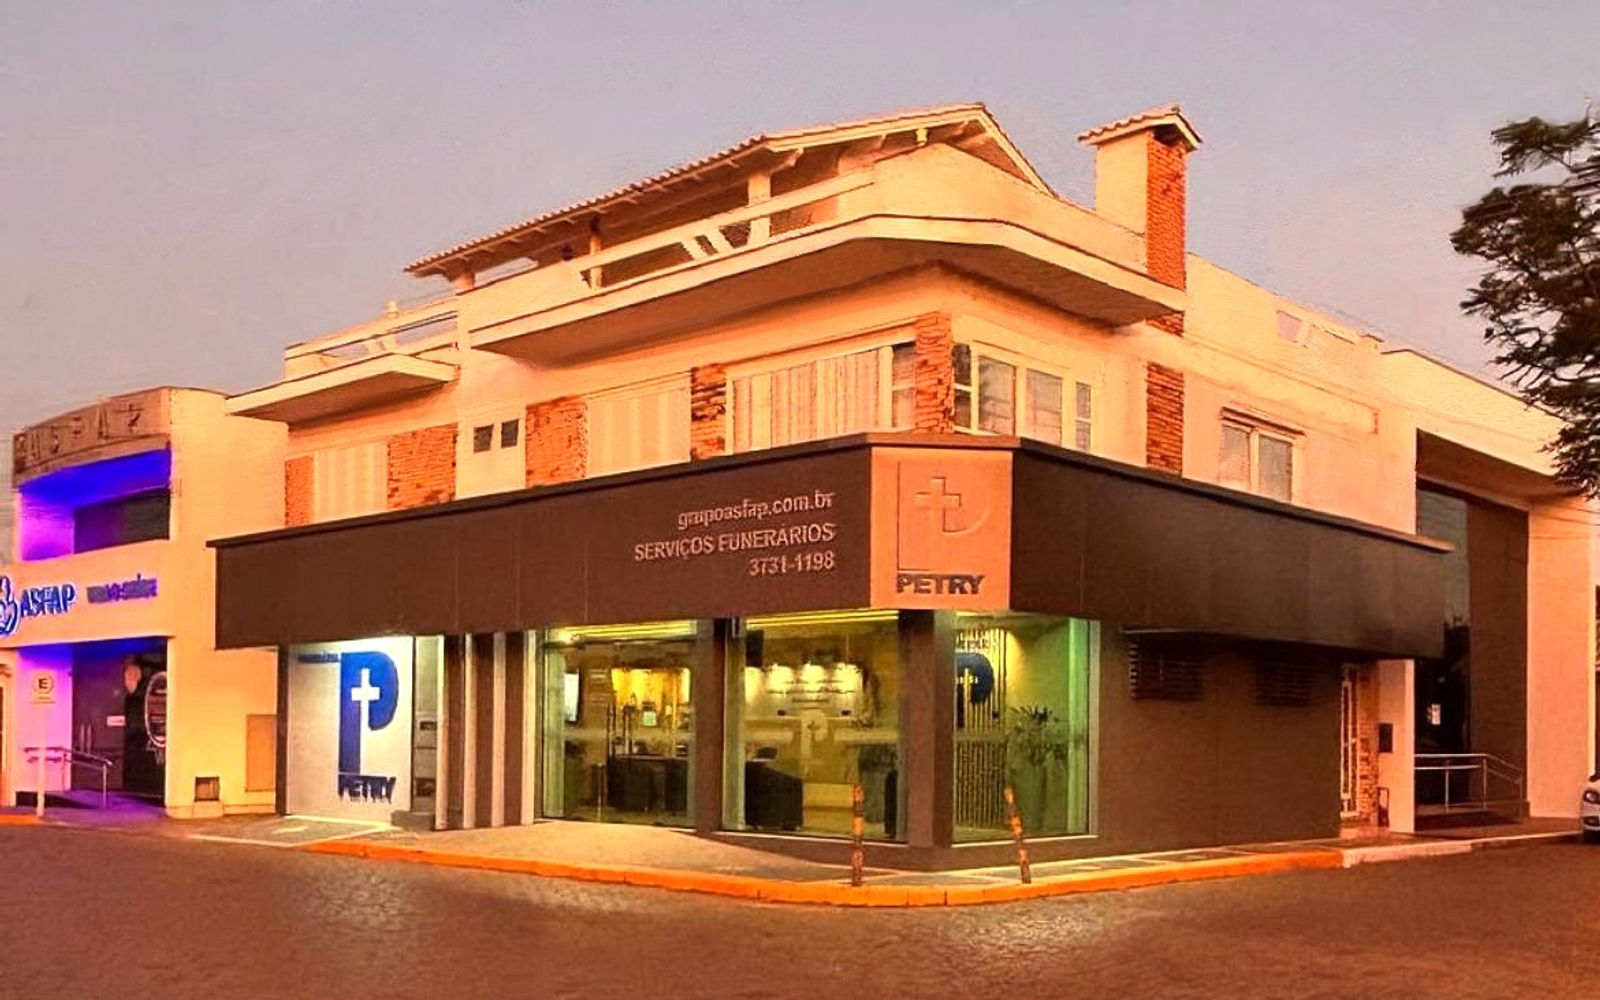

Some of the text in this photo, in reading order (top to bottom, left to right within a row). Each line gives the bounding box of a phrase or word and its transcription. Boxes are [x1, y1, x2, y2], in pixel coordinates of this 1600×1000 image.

[678, 491, 835, 530] grupoasfap.com.br
[634, 522, 835, 561] SERVIÇOS FUNERÁRIOS
[748, 550, 835, 576] 3731-1198
[896, 573, 985, 595] PETRY
